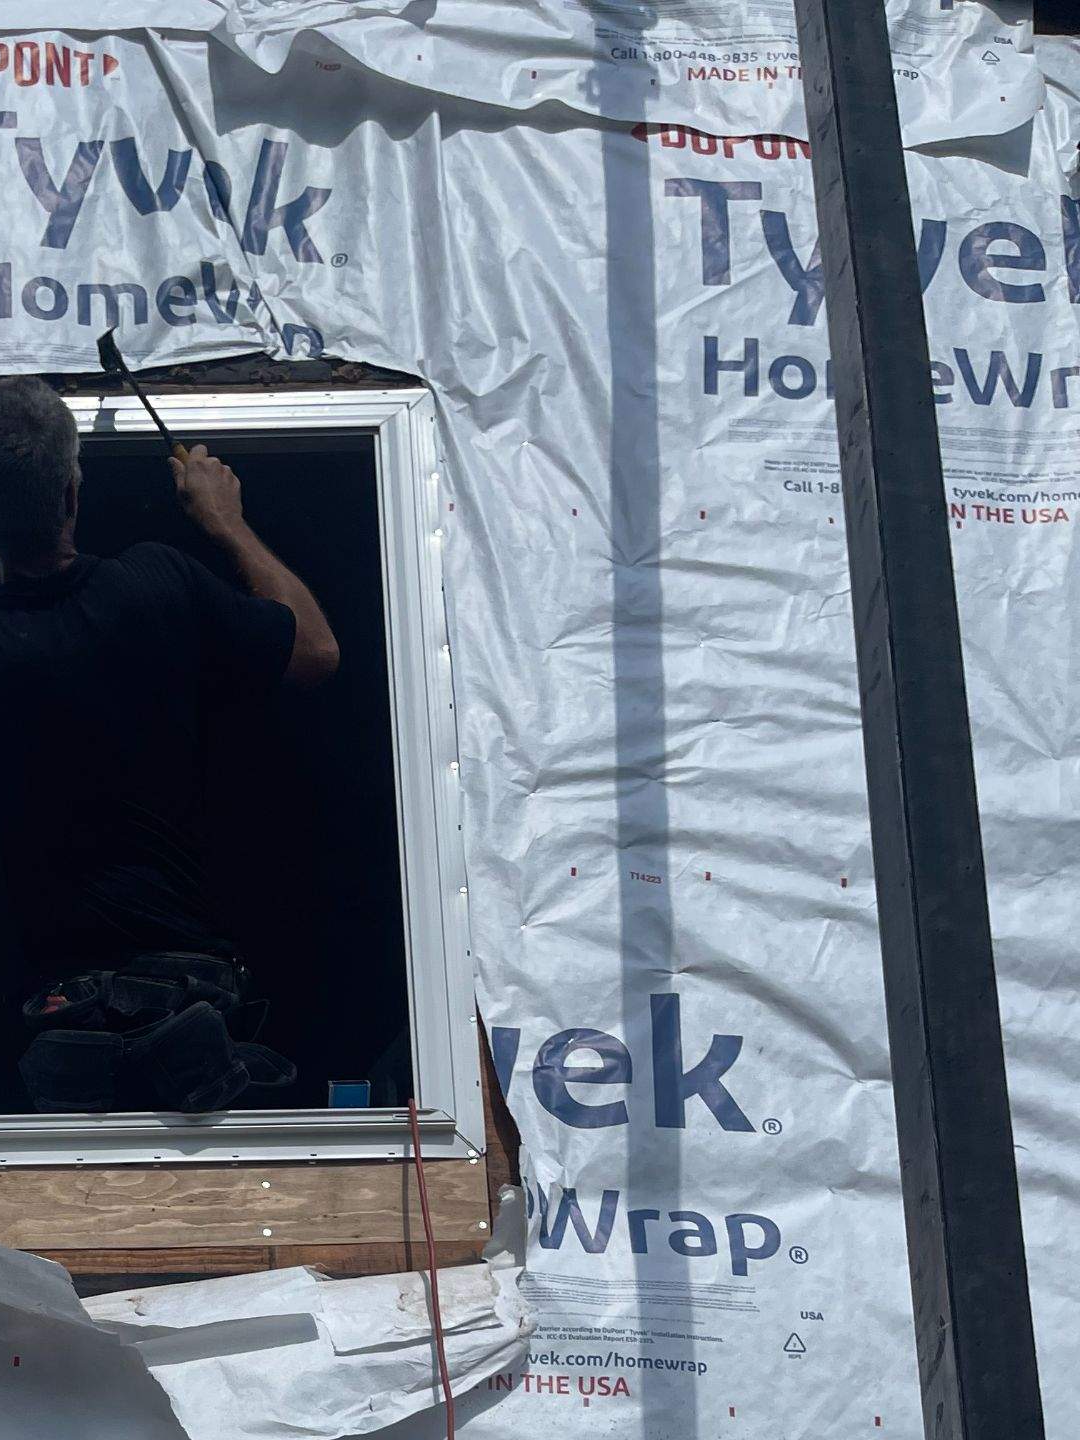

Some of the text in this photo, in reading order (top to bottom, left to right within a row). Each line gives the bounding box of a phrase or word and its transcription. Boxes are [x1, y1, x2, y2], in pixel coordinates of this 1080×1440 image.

[611, 48, 637, 60] Call
[688, 67, 750, 82] MADE
[757, 67, 778, 80] IN
[784, 480, 812, 493] Call
[972, 504, 1015, 524] THE
[1021, 508, 1070, 524] USA
[800, 1311, 824, 1321] USA
[488, 1373, 631, 1397] IN THE USA
